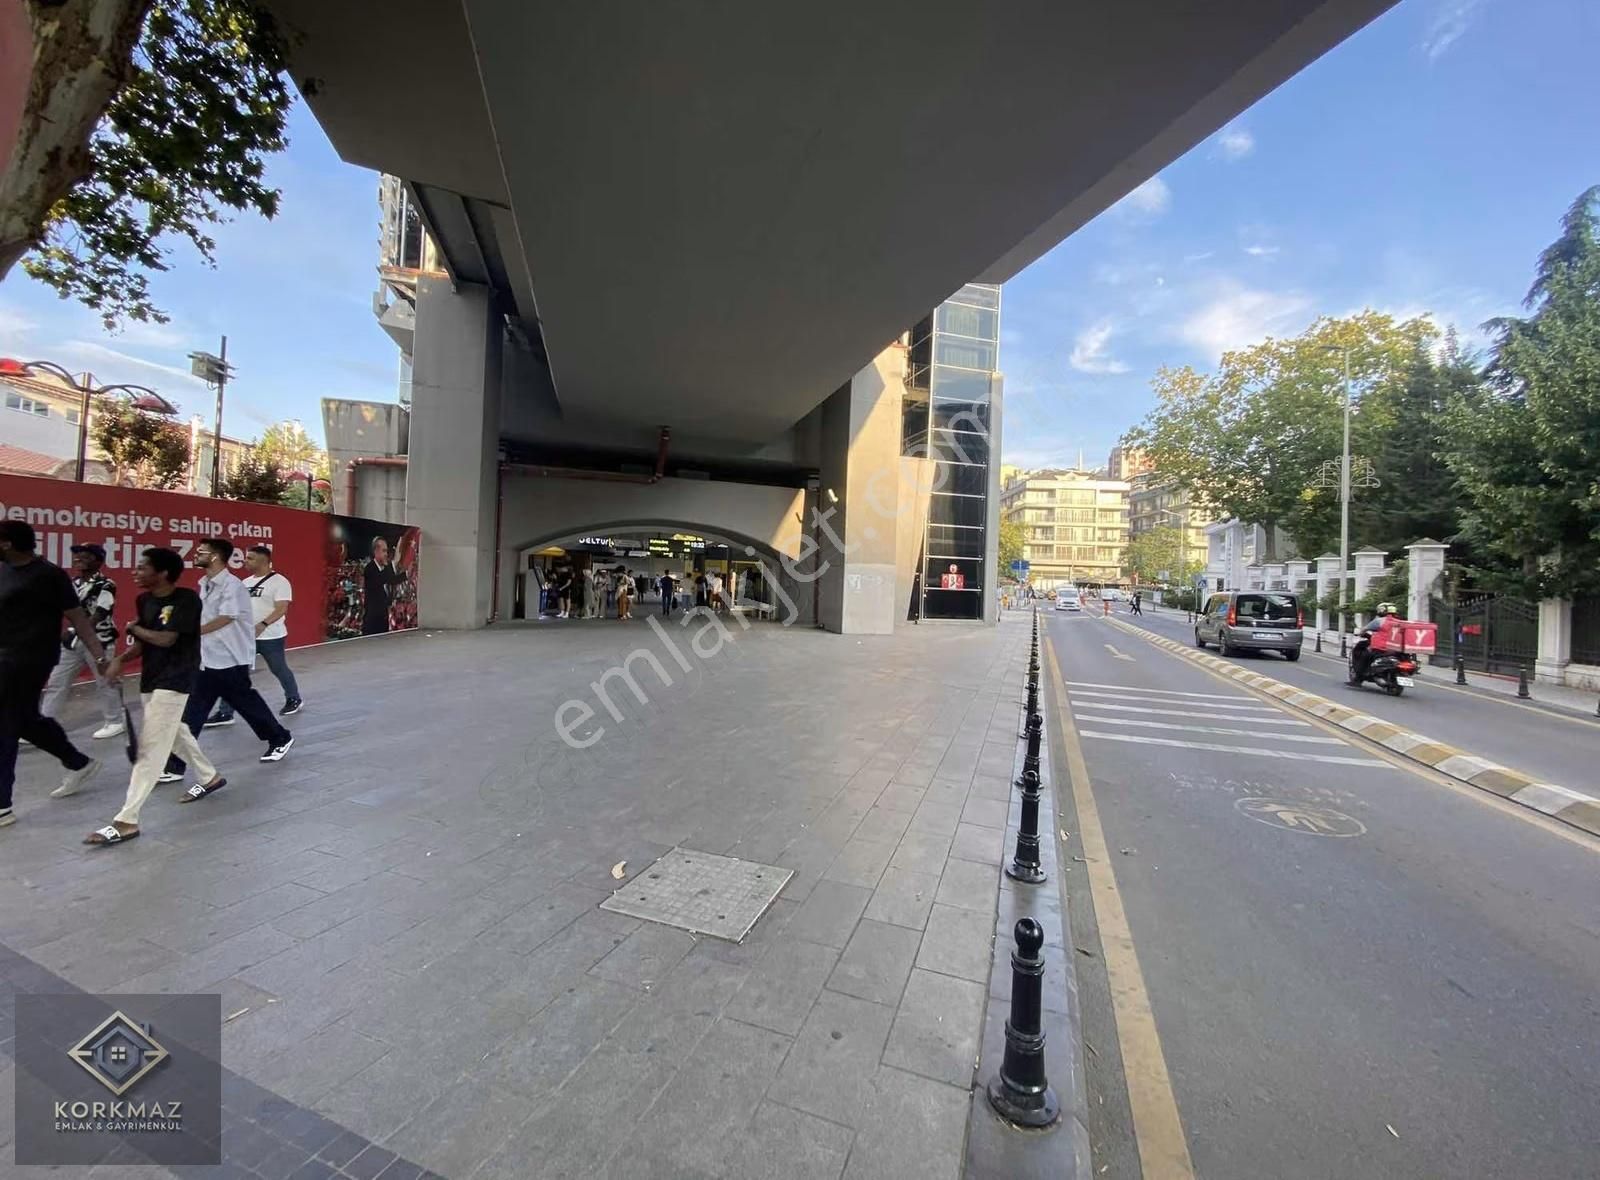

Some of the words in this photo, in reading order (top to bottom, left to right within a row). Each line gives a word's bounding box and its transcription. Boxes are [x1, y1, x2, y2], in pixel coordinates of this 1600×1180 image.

[169, 516, 223, 538] sahip
[228, 521, 272, 538] çıkan
[1415, 630, 1427, 644] Y
